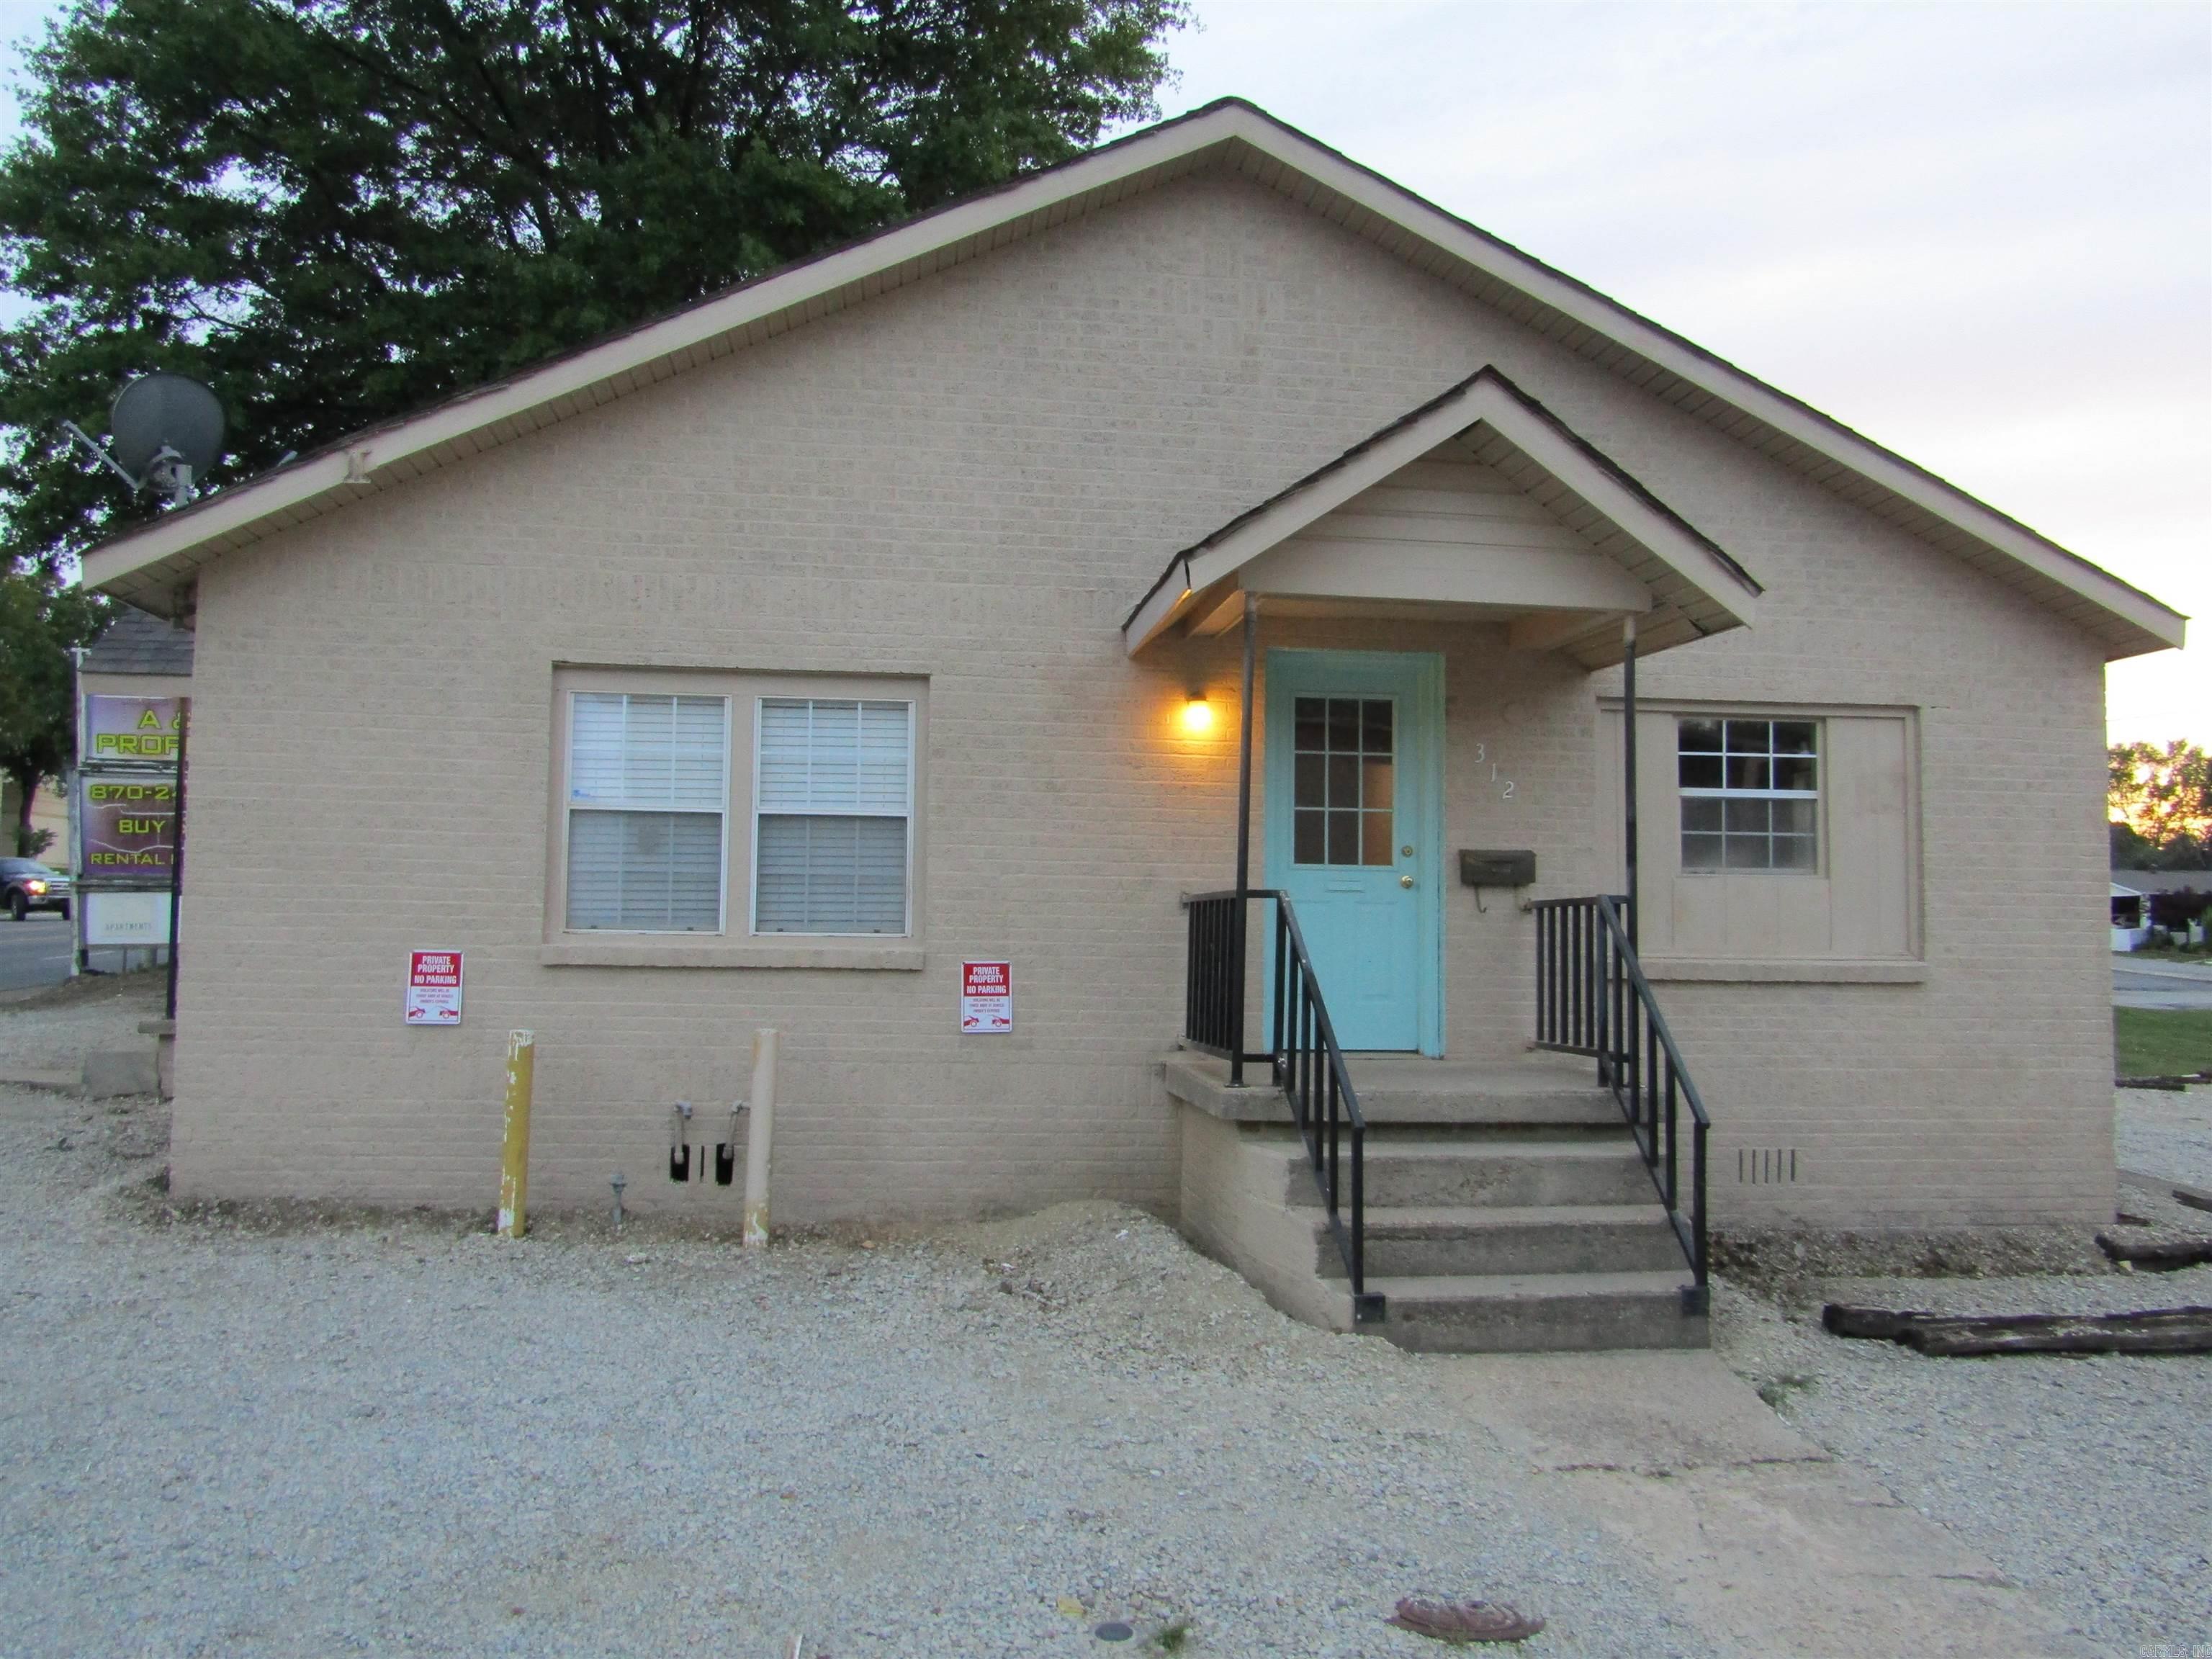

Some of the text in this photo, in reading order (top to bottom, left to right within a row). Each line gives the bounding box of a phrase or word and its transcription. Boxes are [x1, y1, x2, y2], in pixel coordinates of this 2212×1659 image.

[138, 709, 161, 729] A
[1474, 742, 1514, 799] 312
[91, 785, 176, 800] 870-2
[119, 819, 166, 833] BUY
[91, 853, 165, 865] RENTAL
[422, 956, 451, 965] PRIVATE
[418, 964, 454, 974] PROPERTY
[973, 966, 1000, 975] PRIVATE
[414, 975, 457, 984] NO PARKING
[969, 974, 1004, 984] PROPERTY
[966, 985, 1007, 994] NO PARKING
